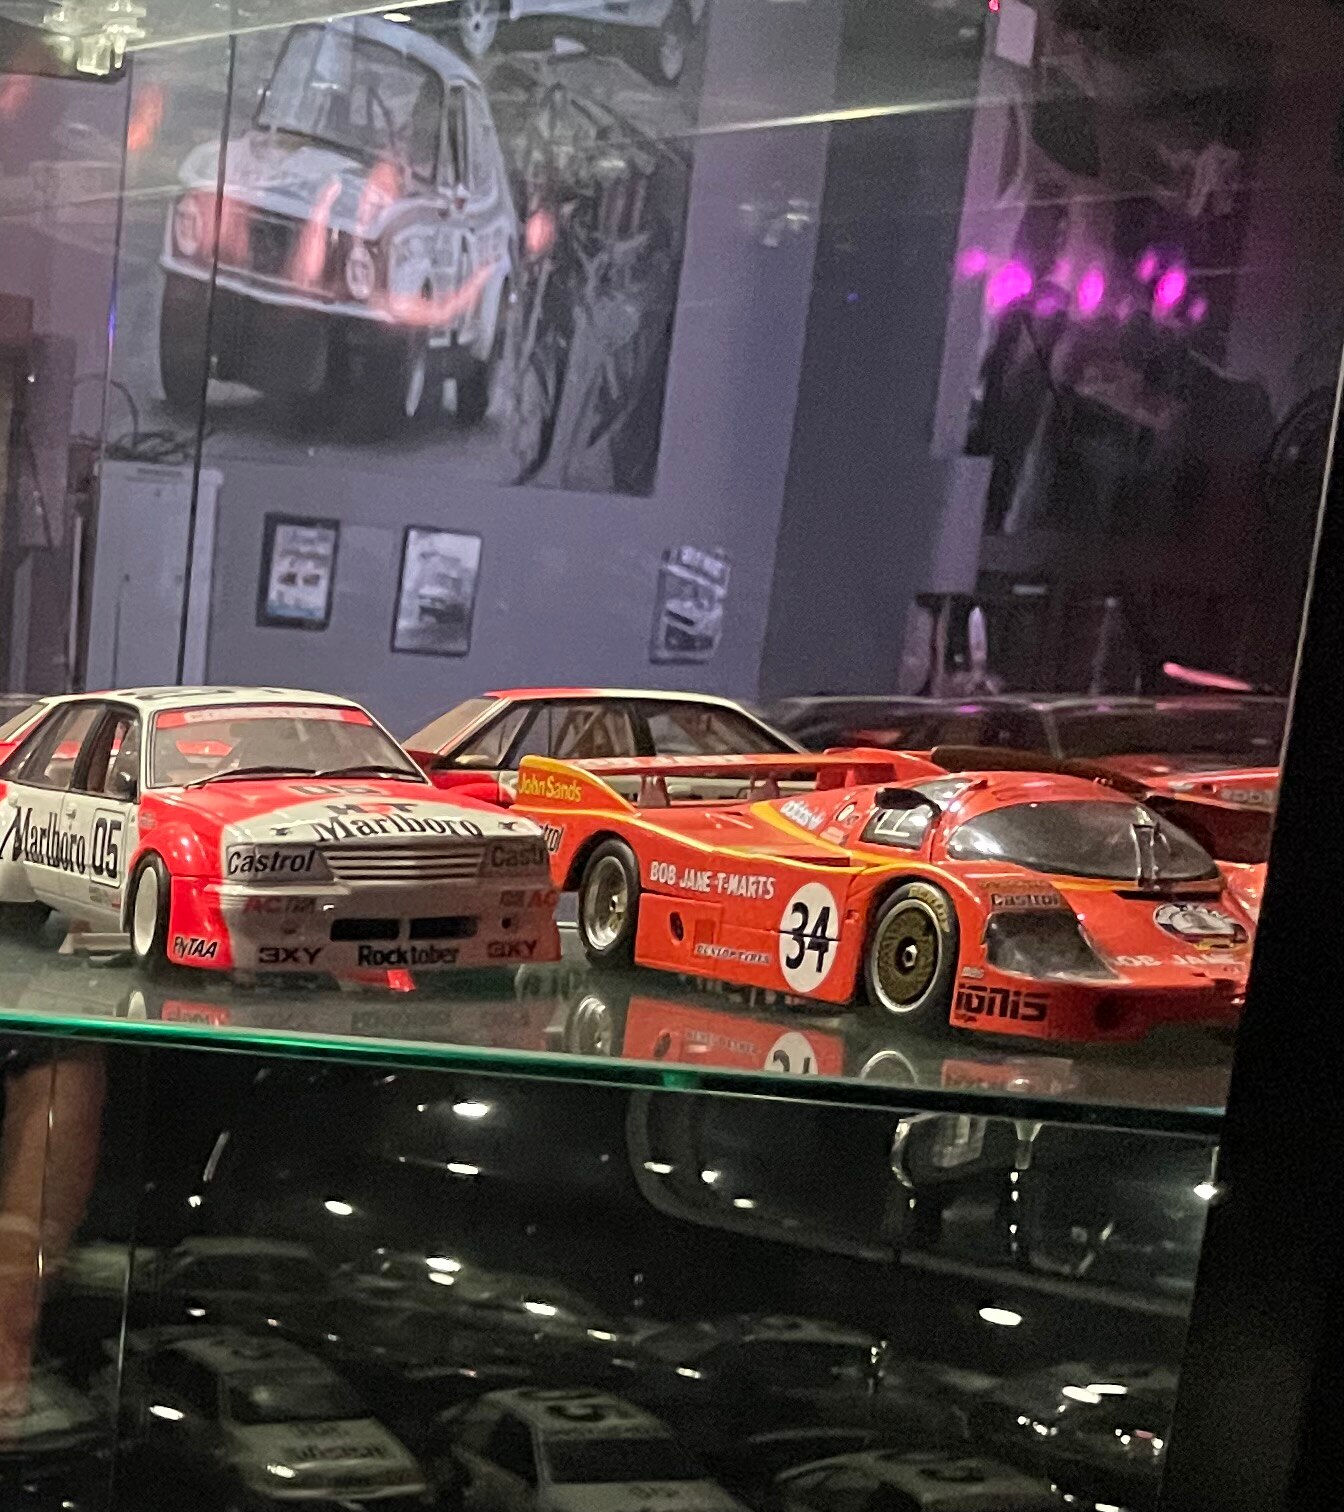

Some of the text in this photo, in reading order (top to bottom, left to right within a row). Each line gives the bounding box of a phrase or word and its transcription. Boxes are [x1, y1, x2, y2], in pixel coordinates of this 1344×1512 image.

[0, 805, 88, 876] Marlboro
[91, 815, 121, 880] 05
[312, 812, 483, 843] Marlboro
[227, 848, 315, 877] Castrol
[649, 861, 676, 886] BOB
[679, 866, 711, 893] JANE
[785, 902, 831, 973] 34
